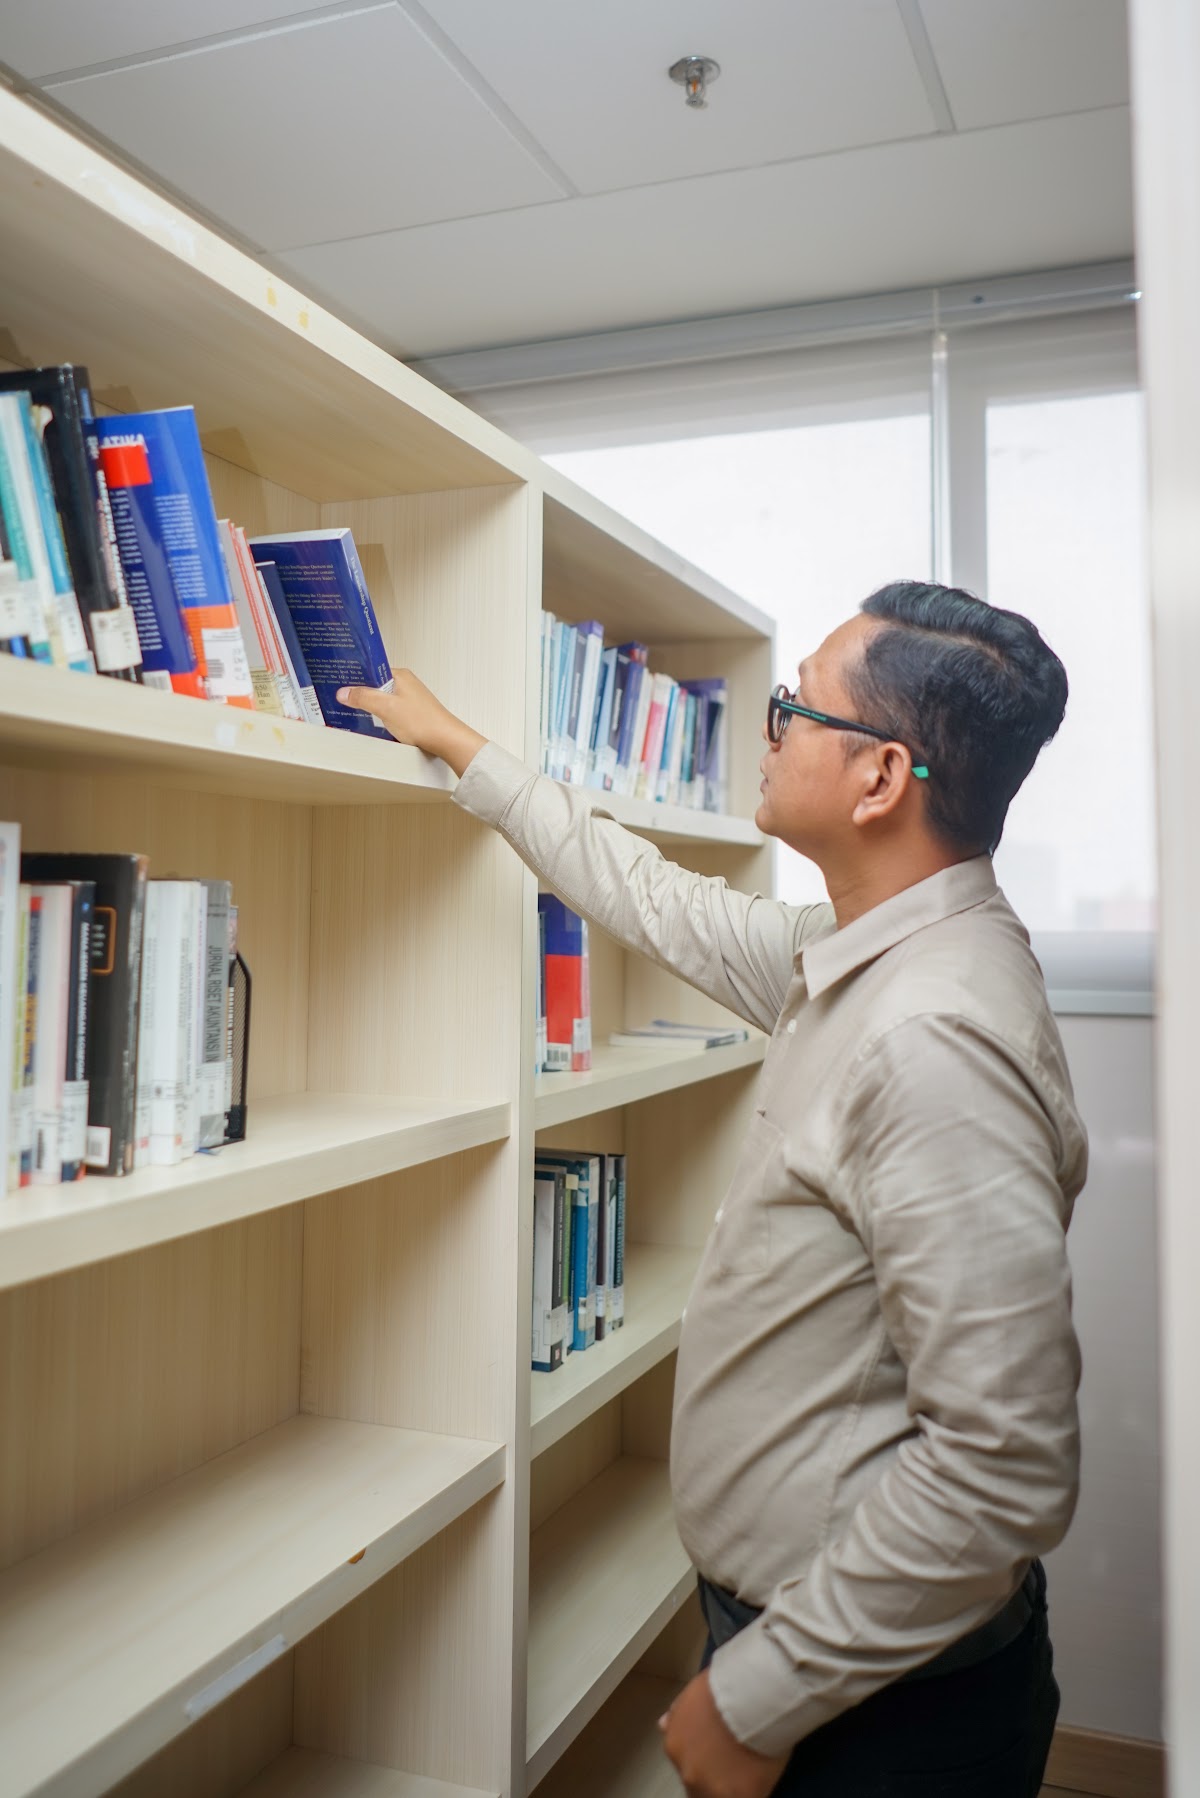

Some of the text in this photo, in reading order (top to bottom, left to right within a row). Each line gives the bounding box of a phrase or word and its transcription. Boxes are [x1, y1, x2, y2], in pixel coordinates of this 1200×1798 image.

[96, 470, 116, 542] MARKETING
[354, 570, 367, 607] Leadership
[363, 606, 374, 636] Quotient
[79, 922, 90, 981] MANAJEMEN
[208, 946, 222, 979] JURNAL
[78, 982, 88, 1034] KEUANGAN
[207, 980, 222, 1004] RISET
[206, 1006, 221, 1052] AKUNTANSI
